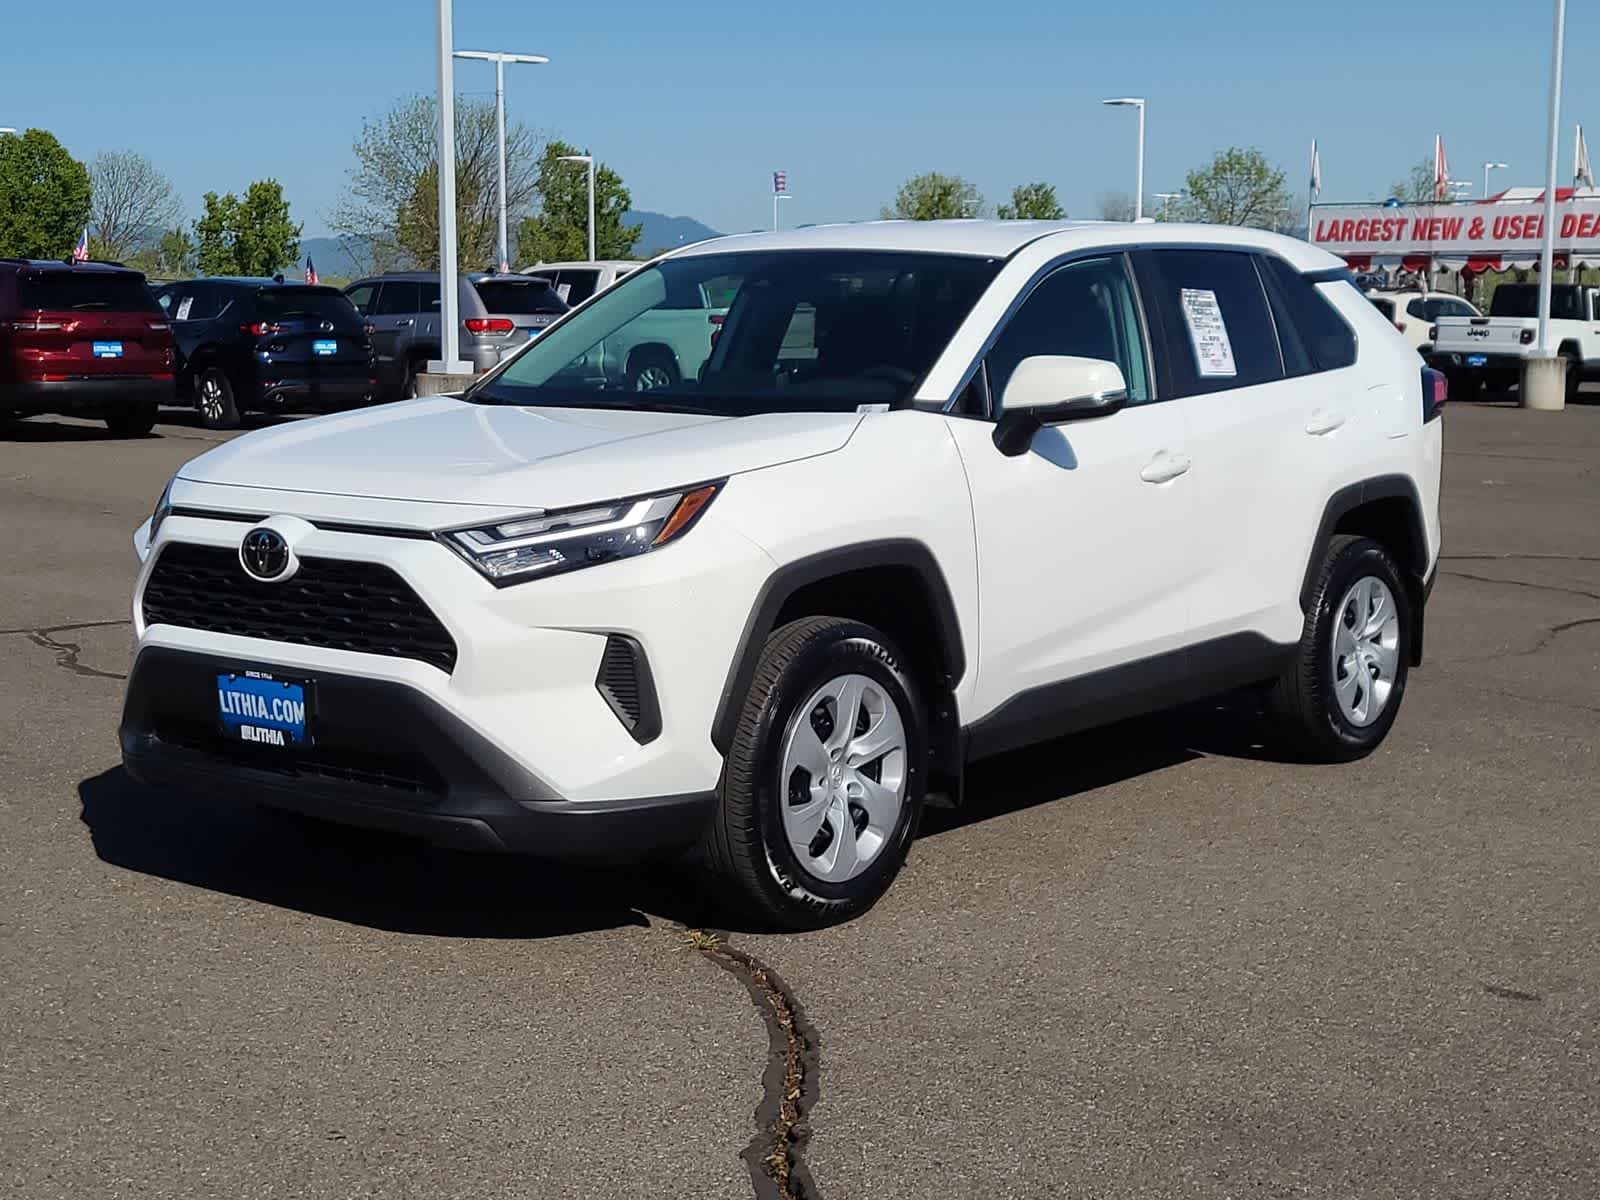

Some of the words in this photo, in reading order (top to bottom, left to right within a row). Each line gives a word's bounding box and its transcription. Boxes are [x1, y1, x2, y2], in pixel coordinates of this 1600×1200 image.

[1315, 217, 1409, 242] LARGEST
[1411, 216, 1465, 241] NEW
[1468, 216, 1486, 240] &
[1466, 327, 1490, 338] Jeep
[218, 688, 306, 726] LITHIA.COM
